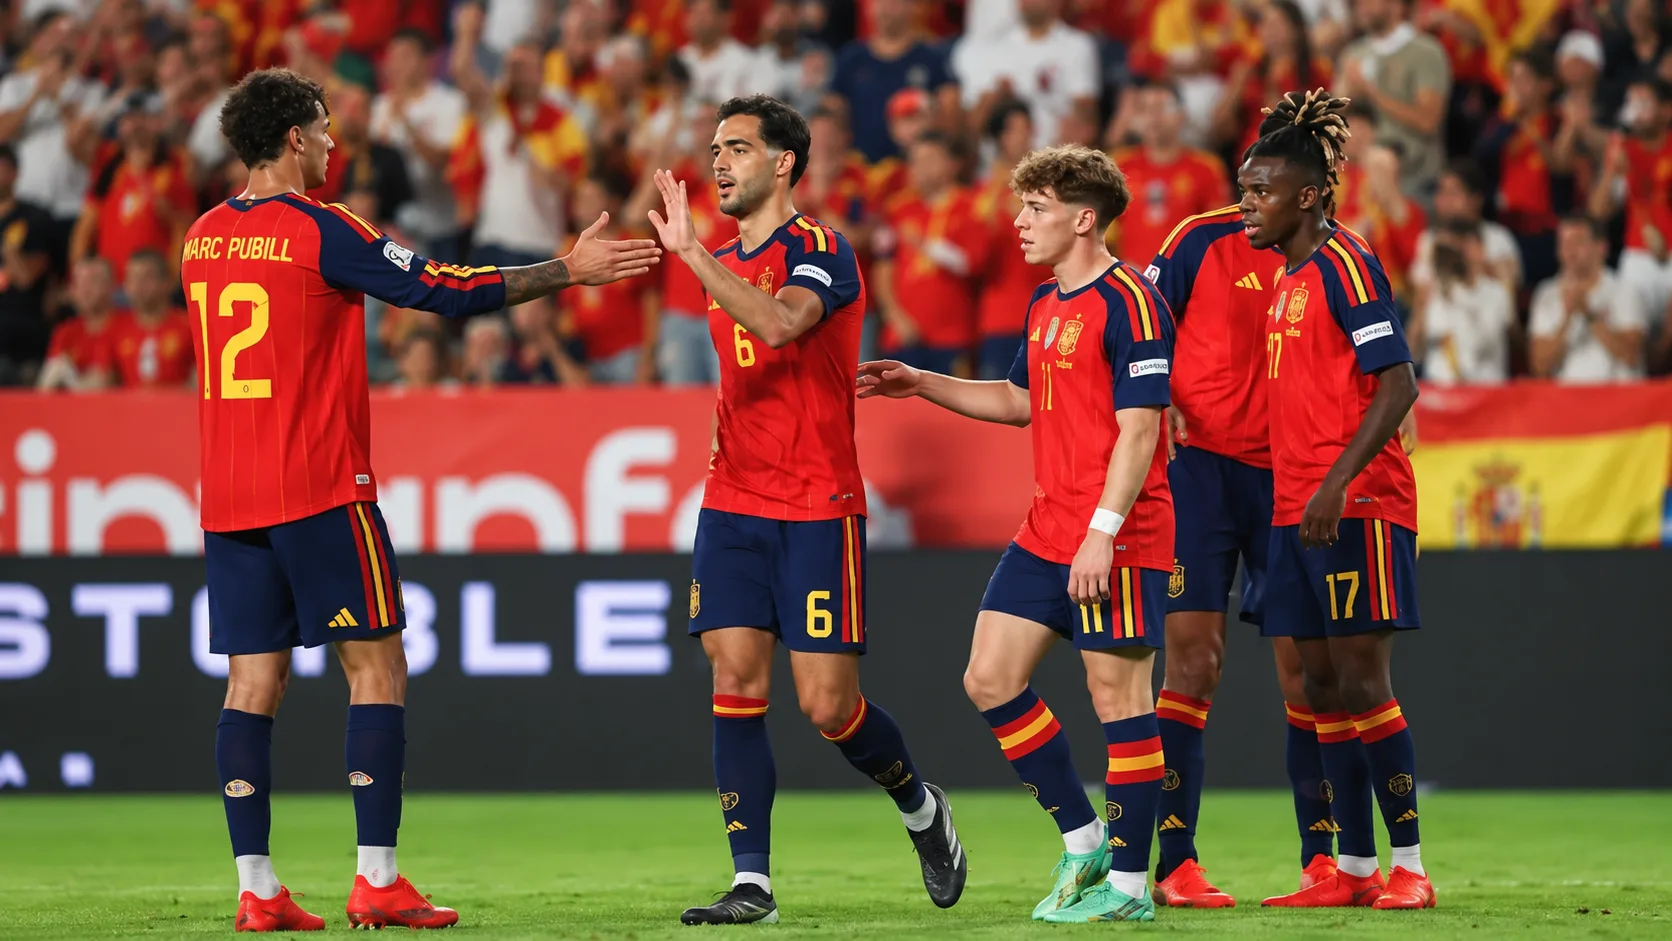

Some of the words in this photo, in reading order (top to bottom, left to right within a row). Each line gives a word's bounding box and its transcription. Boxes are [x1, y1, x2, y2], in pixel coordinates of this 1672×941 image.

[182, 237, 223, 263] MARC
[227, 237, 293, 262] PUBILL
[190, 282, 272, 399] 12
[733, 323, 756, 368] 6
[1041, 362, 1053, 410] 11
[806, 590, 833, 638] 6
[1326, 571, 1360, 620] 17
